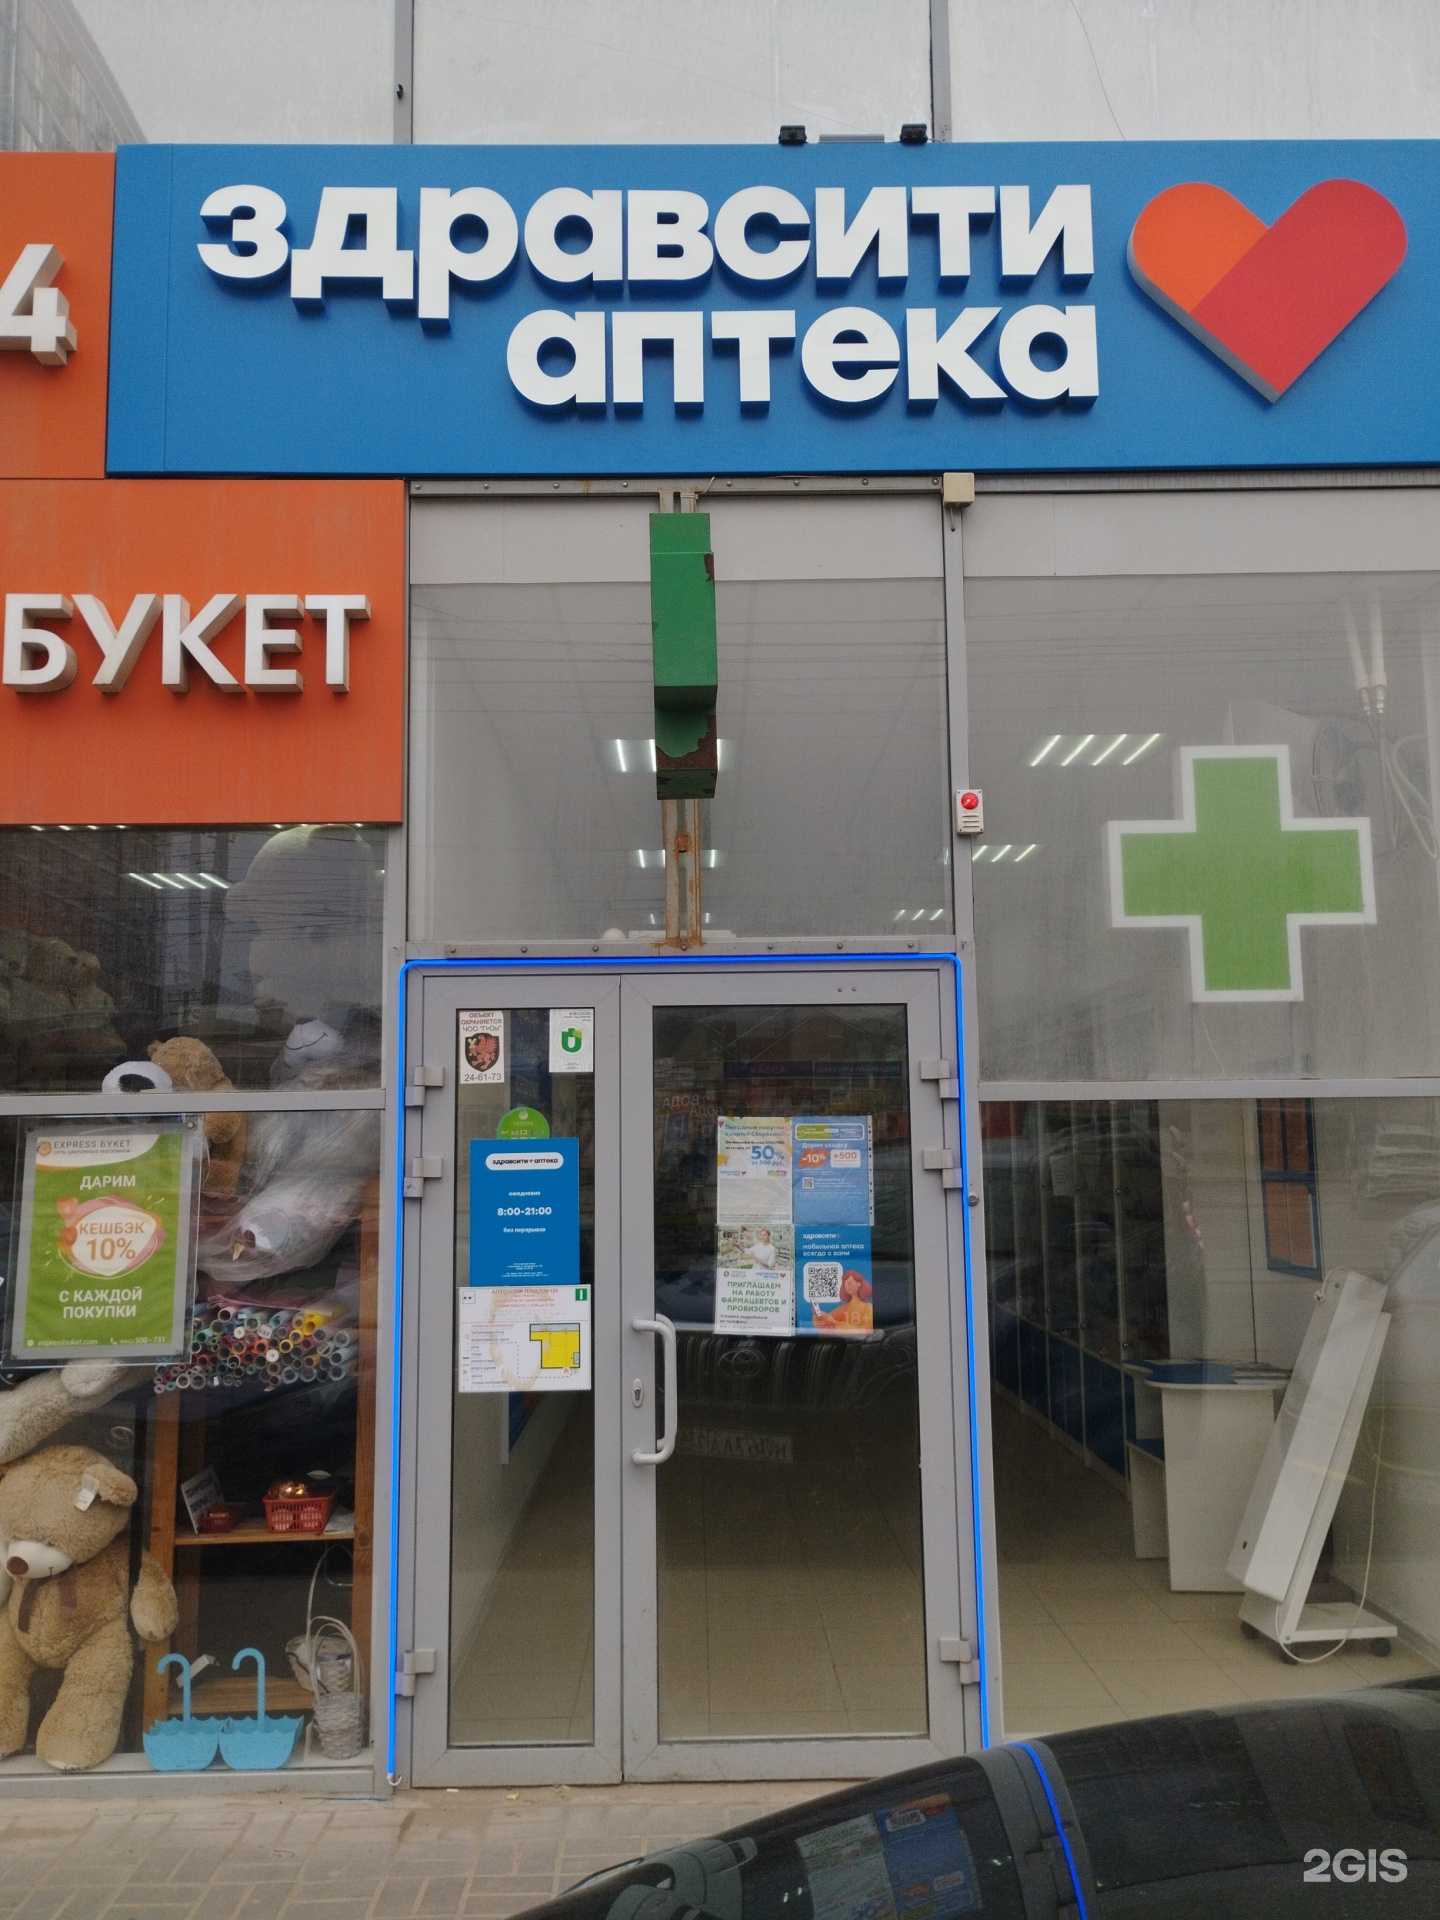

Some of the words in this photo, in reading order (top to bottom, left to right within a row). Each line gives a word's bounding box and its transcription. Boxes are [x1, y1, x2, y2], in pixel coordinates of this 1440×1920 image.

[197, 184, 1096, 325] здравсити
[0, 243, 76, 366] 4
[506, 303, 1100, 415] аптека
[2, 592, 371, 694] БУКЕТ
[54, 1140, 97, 1149] EXPRESS
[80, 1175, 136, 1191] ДАРИМ
[497, 1206, 552, 1217] 8:00-21:00
[80, 1222, 145, 1234] КЕШБЭК
[86, 1238, 136, 1261] 10%
[59, 1290, 70, 1303] С
[73, 1286, 143, 1304] КАЖДОЙ
[63, 1304, 137, 1319] ПОКУПКИ
